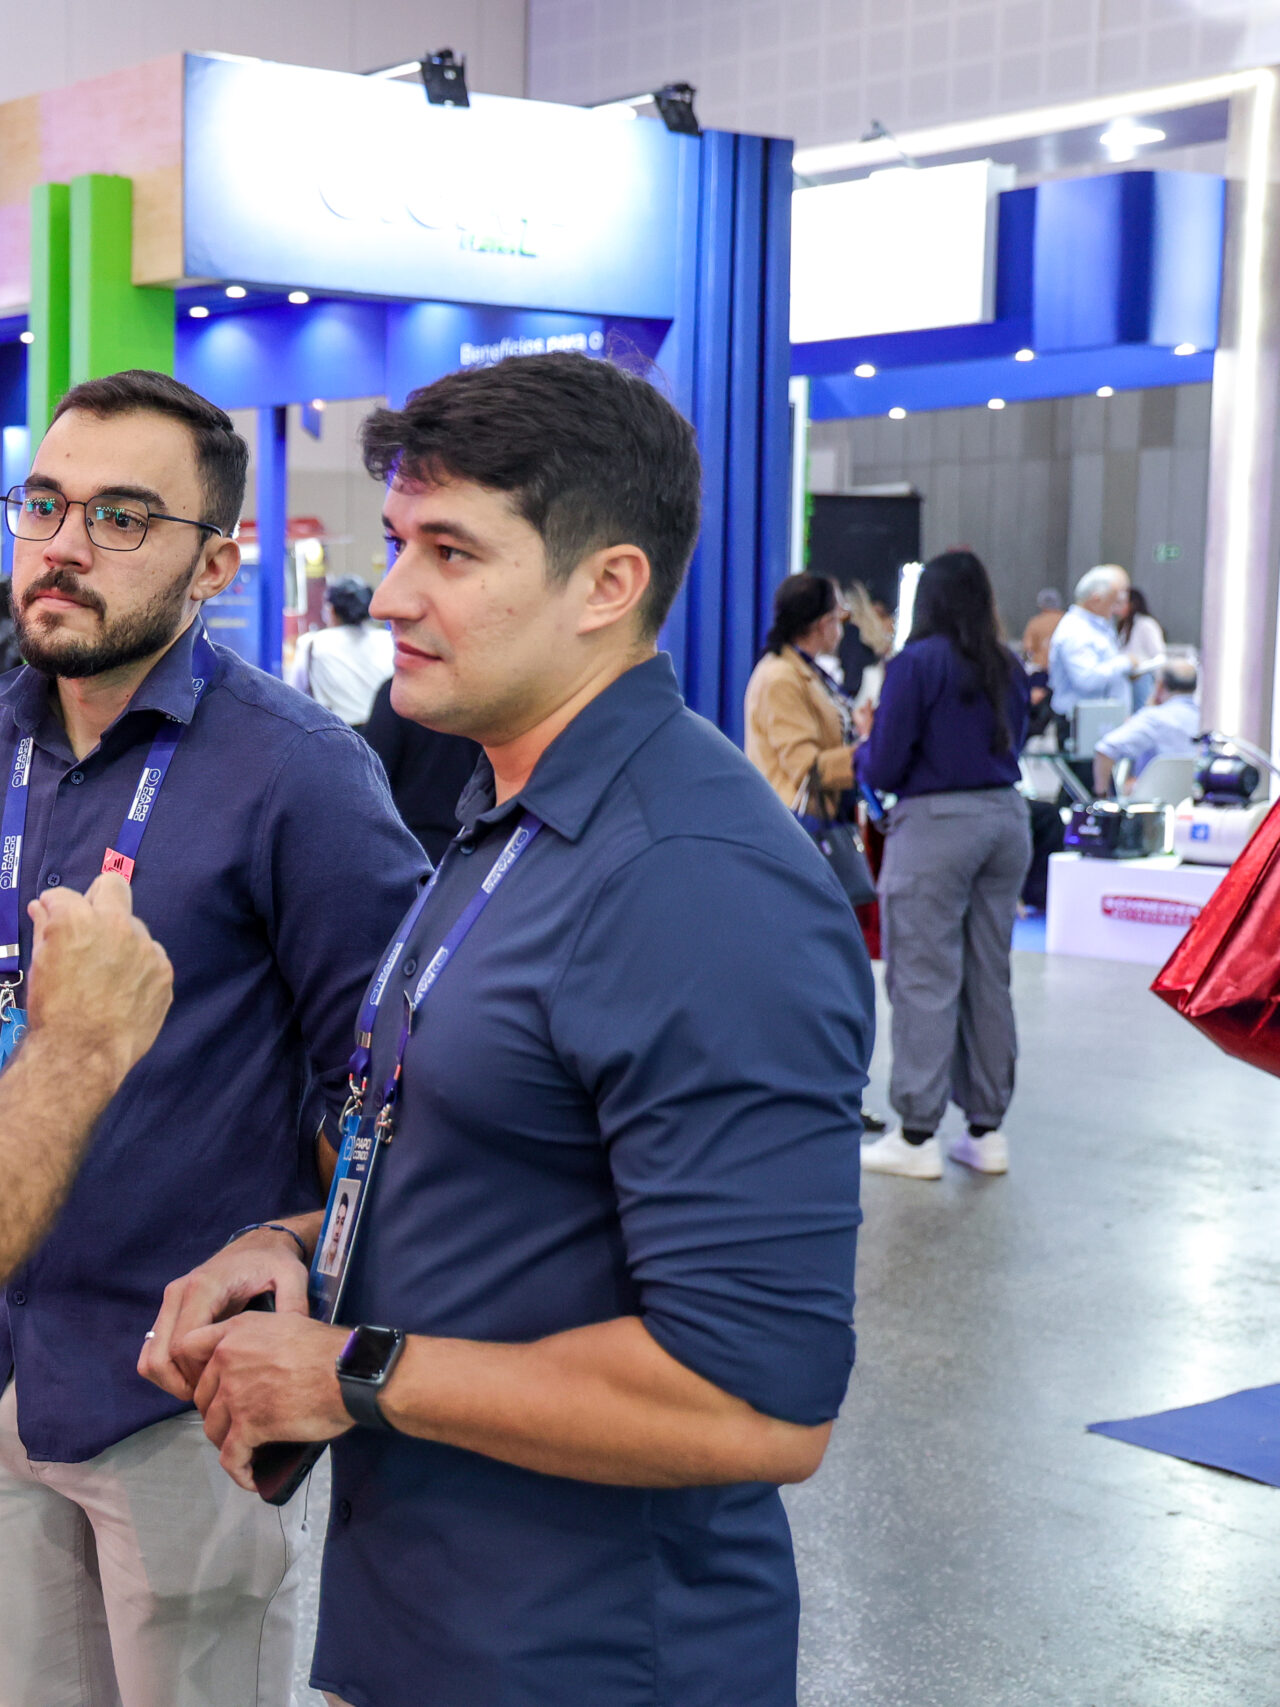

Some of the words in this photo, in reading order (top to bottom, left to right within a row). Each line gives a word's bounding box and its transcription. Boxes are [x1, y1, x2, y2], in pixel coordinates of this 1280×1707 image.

[15, 738, 26, 770] PAPO
[133, 787, 149, 821] CONDO
[138, 787, 156, 822] PAPO
[1, 836, 11, 870] PAPO
[7, 835, 16, 870] CONDO
